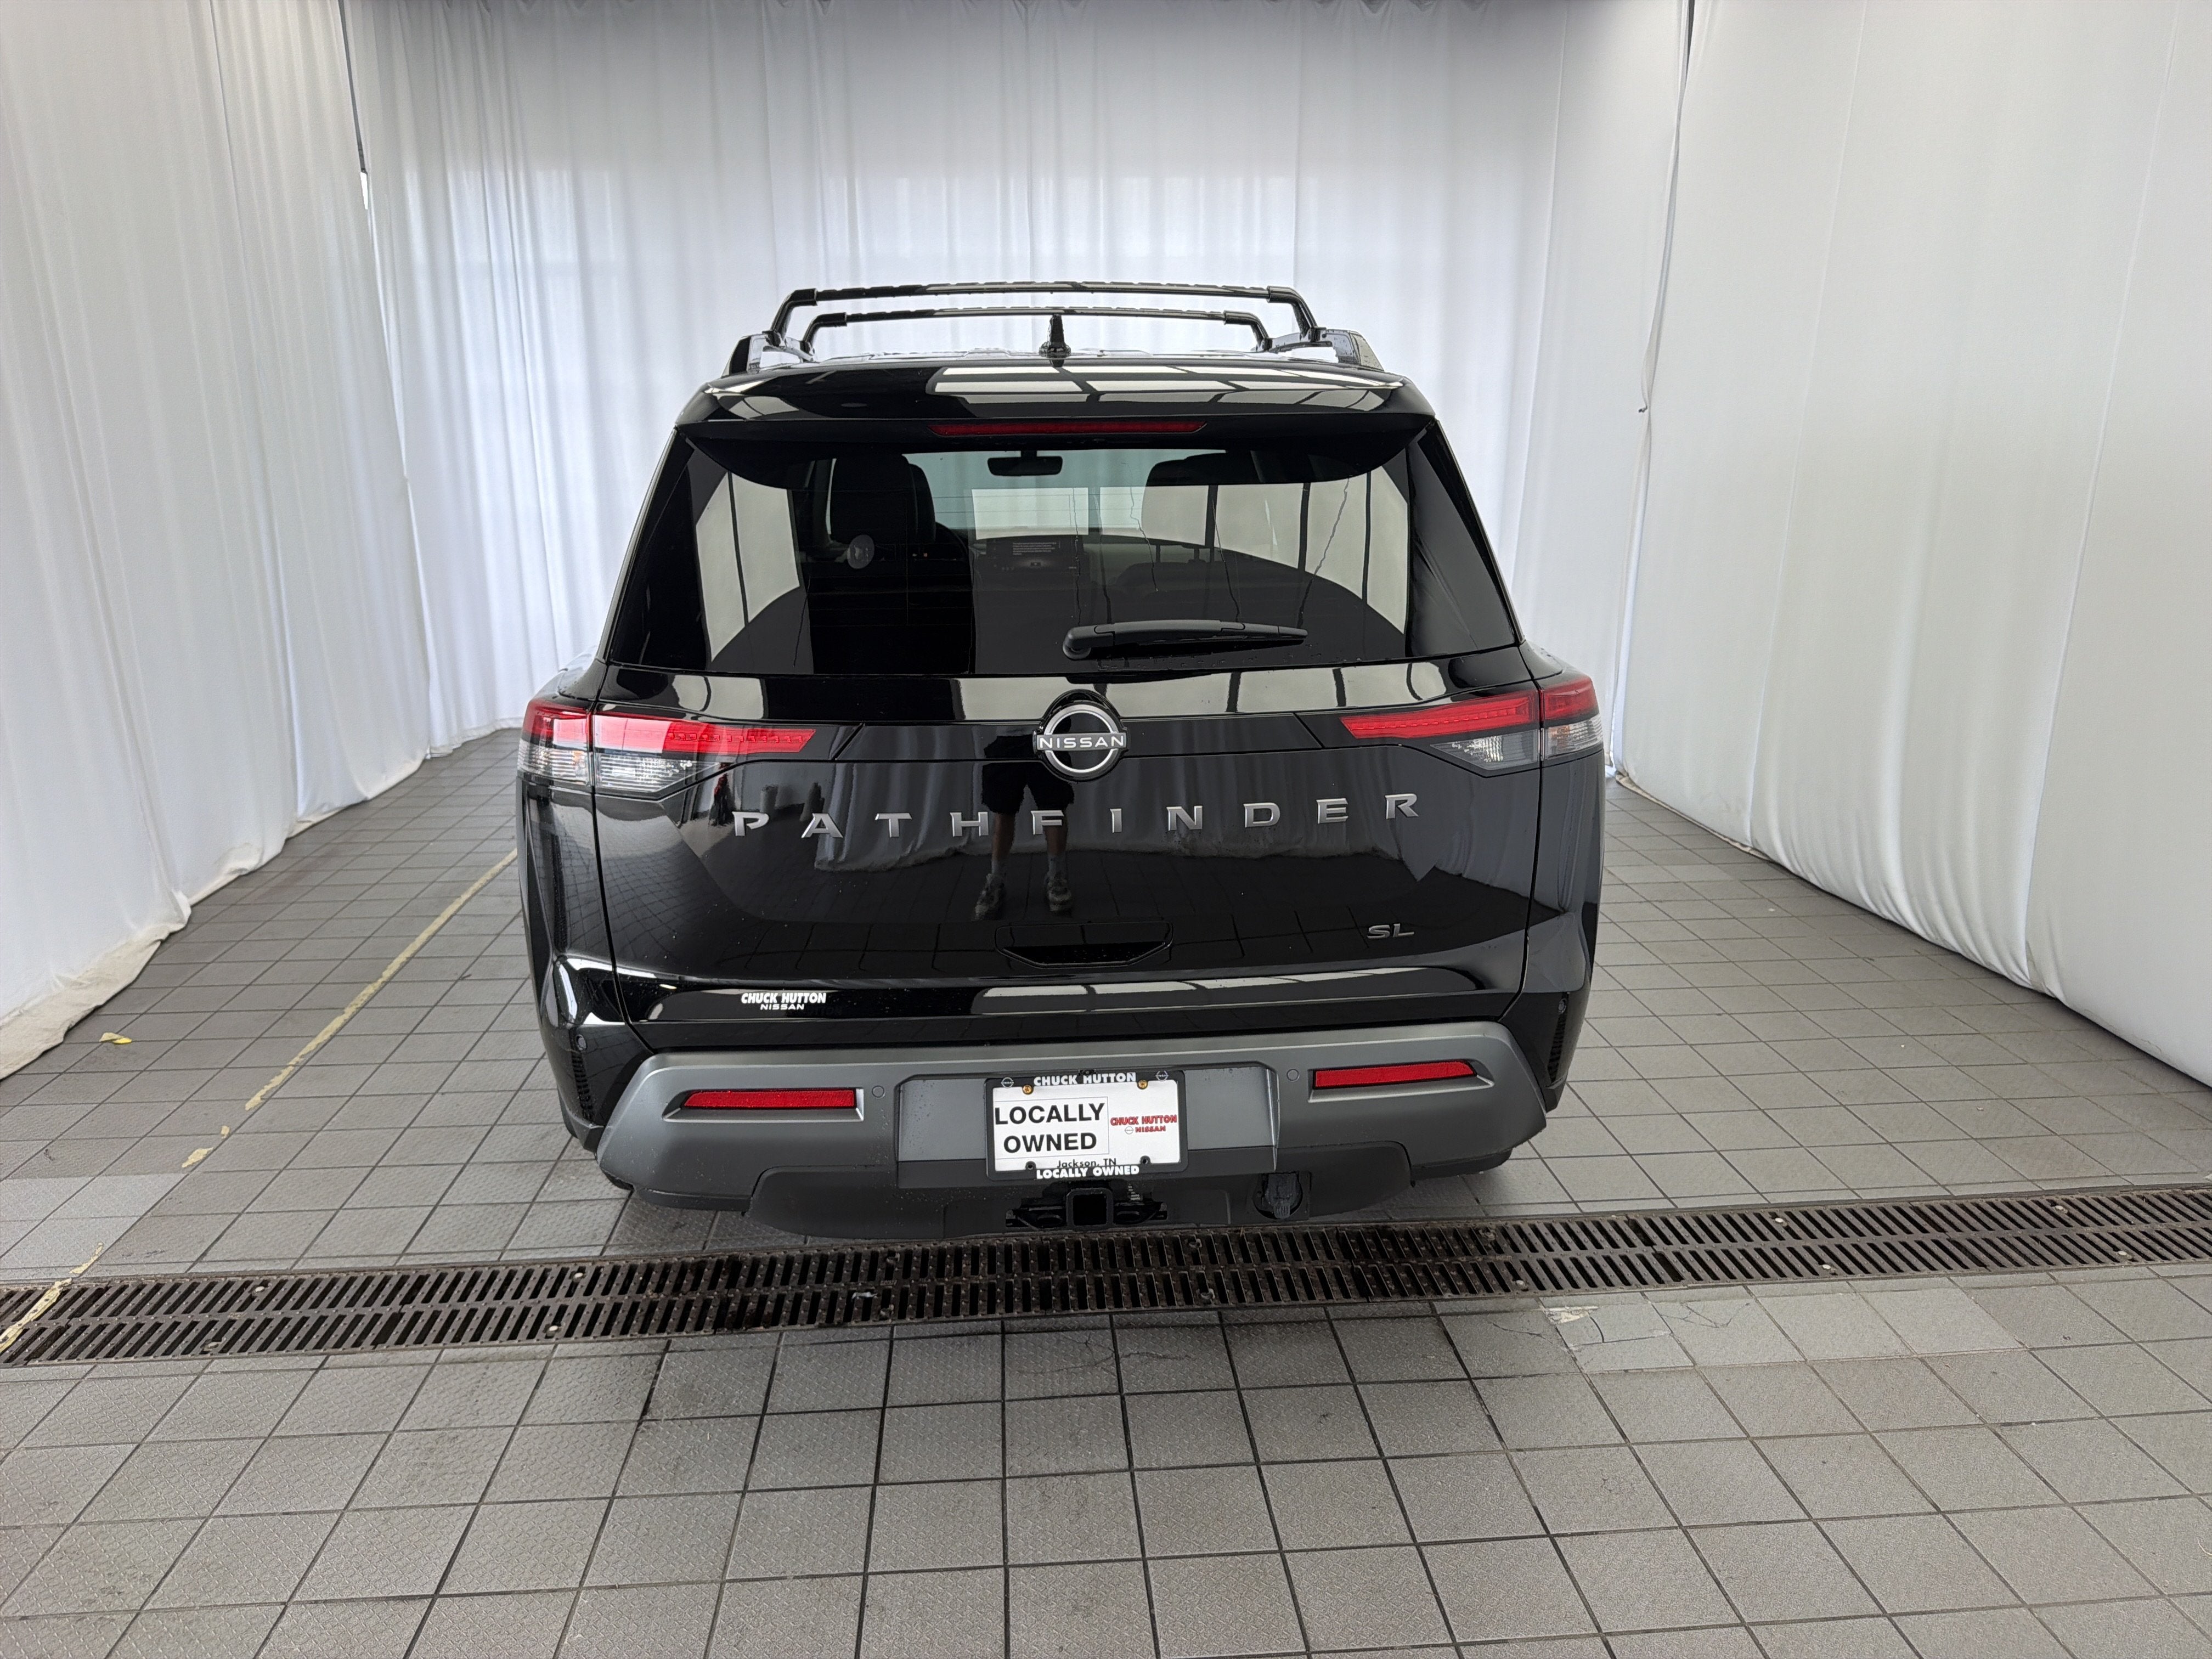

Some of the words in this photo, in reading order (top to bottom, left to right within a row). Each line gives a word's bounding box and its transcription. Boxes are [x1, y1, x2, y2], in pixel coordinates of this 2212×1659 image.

[1040, 736, 1124, 748] NISSAN
[732, 793, 1419, 838] PATHFINDER
[1367, 923, 1414, 939] SL
[741, 992, 778, 1003] CHUCK
[781, 992, 827, 1003] HUTTON
[1034, 1075, 1078, 1086] CHUCK
[1083, 1072, 1136, 1084] HUTTON
[995, 1103, 1105, 1125] LOCALLY
[1110, 1116, 1139, 1126] CHUCK
[1142, 1114, 1177, 1124] HUTTON
[1003, 1132, 1097, 1153] OWNED
[1103, 1158, 1116, 1166] TN
[1036, 1167, 1088, 1180] LOCALLY
[1093, 1165, 1139, 1177] OWNED
